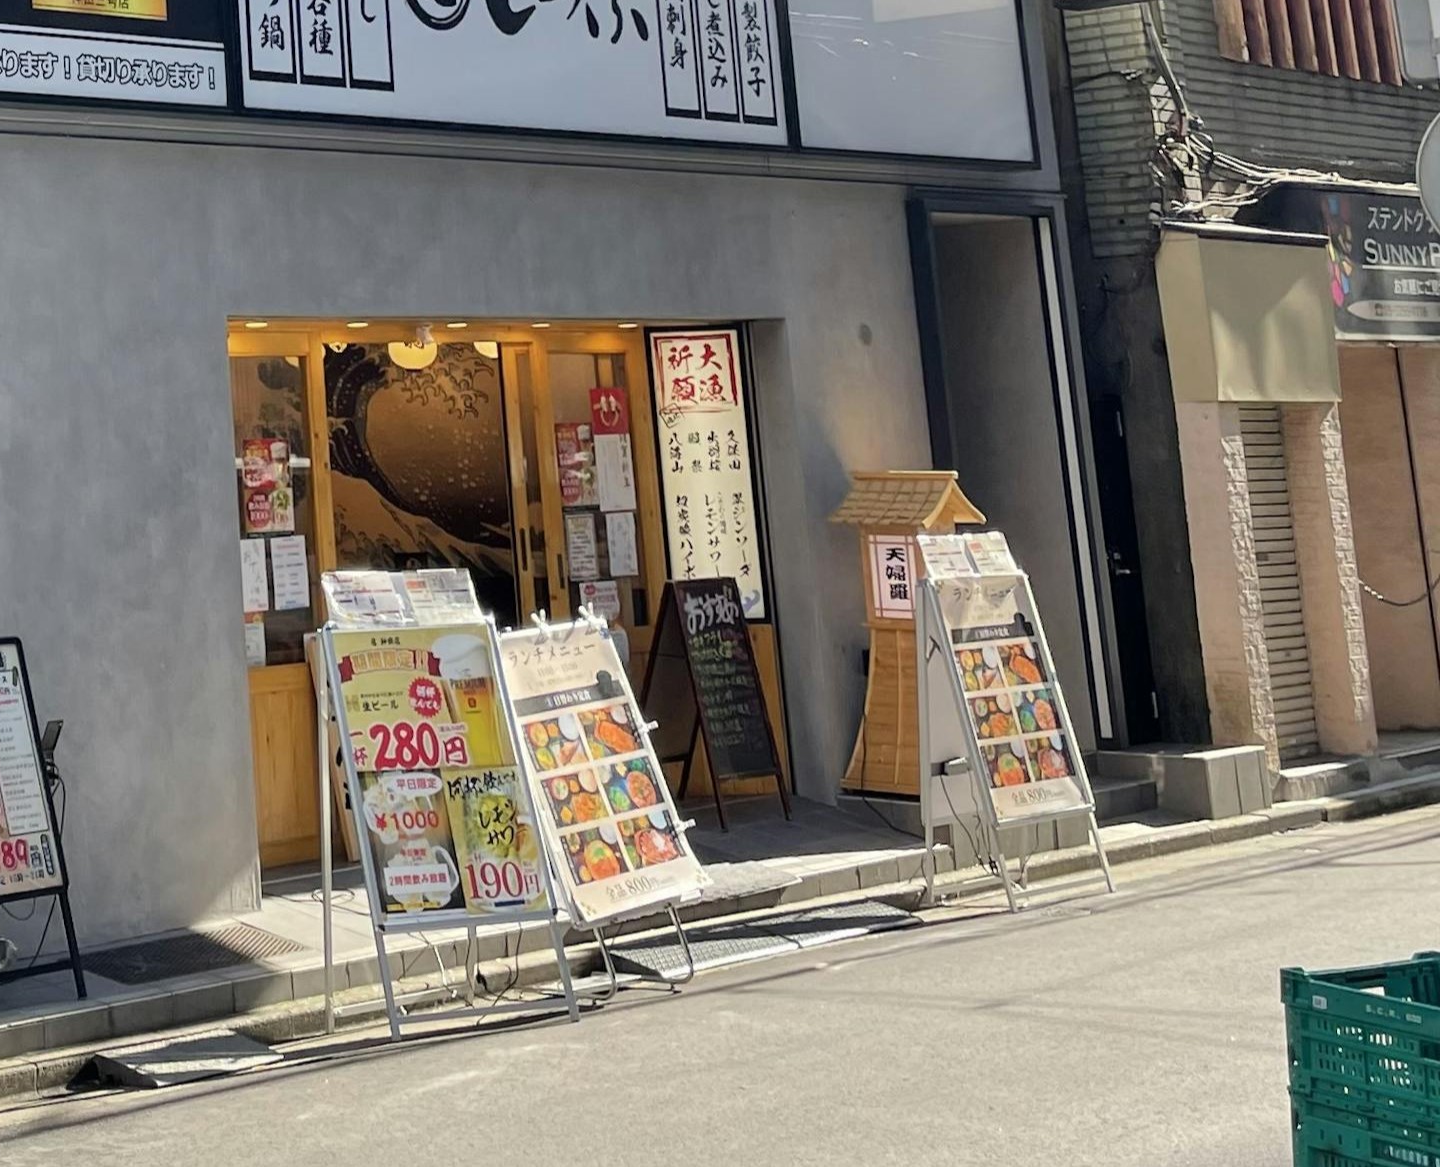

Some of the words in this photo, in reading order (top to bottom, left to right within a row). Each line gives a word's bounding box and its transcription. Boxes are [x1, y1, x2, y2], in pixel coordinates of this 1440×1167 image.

[508, 643, 596, 668] ランチメニュー
[362, 699, 399, 712] 生ビール
[396, 778, 437, 791] 平日限定
